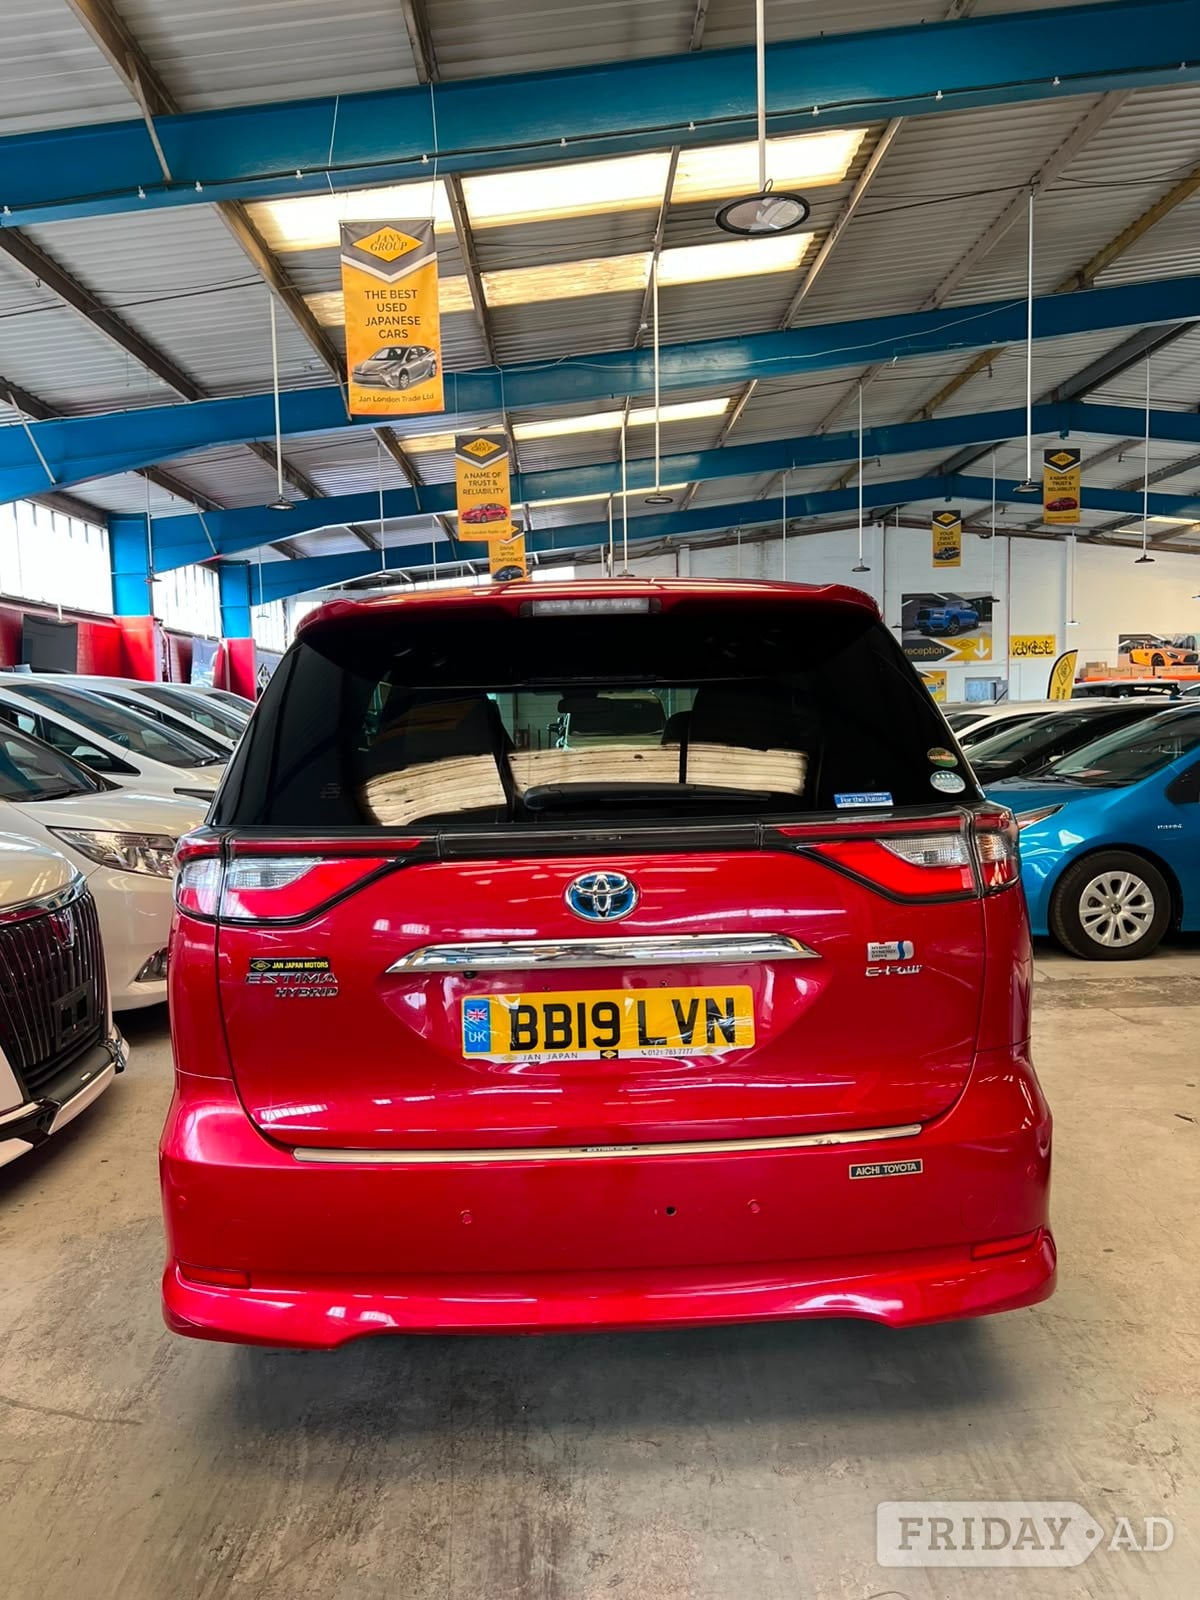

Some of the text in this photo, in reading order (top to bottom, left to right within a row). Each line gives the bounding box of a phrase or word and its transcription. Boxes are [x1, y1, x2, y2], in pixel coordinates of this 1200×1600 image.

[370, 241, 408, 252] GROUP
[364, 289, 418, 299] THE BEST
[376, 302, 408, 312] USED
[365, 315, 421, 327] JAPANESE
[378, 328, 409, 339] CARS
[373, 395, 400, 403] London
[402, 394, 421, 402] Trade
[422, 392, 434, 400] Ltd
[470, 471, 490, 479] NAME
[492, 471, 501, 479] OF
[468, 479, 490, 487] TRUST
[462, 487, 505, 496] RELIABILITY
[904, 646, 945, 656] reception
[304, 961, 329, 969] MOTORS
[245, 972, 338, 984] ESTIMA
[274, 987, 339, 998] HYBRID
[509, 997, 736, 1051] BB19 LVN
[469, 1031, 487, 1043] UK
[523, 1052, 578, 1061] JAN JAPAN
[855, 1162, 917, 1176] AICHI TOYOTA
